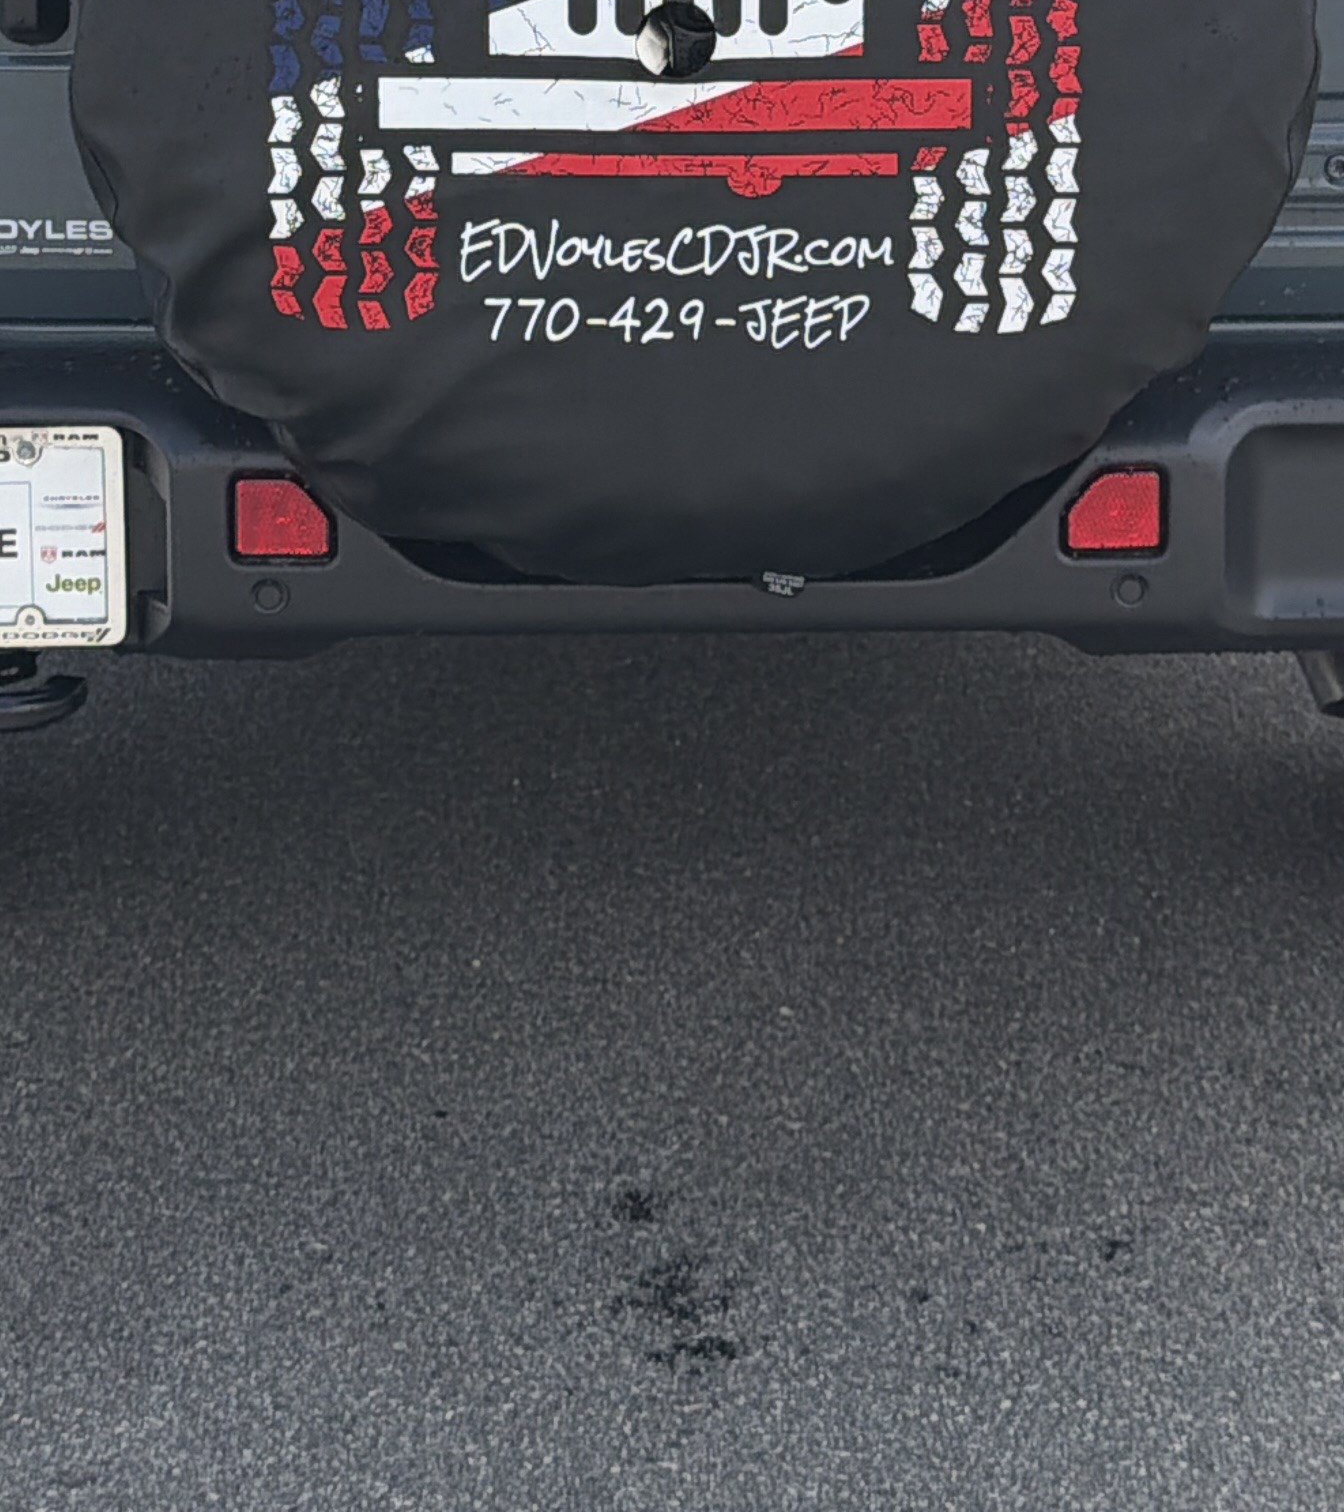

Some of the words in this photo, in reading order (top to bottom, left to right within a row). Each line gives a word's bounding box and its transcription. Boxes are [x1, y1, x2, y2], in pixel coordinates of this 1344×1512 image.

[483, 294, 871, 350] 770-429-JEEP
[53, 433, 100, 442] RAM
[45, 573, 101, 595] Jeep
